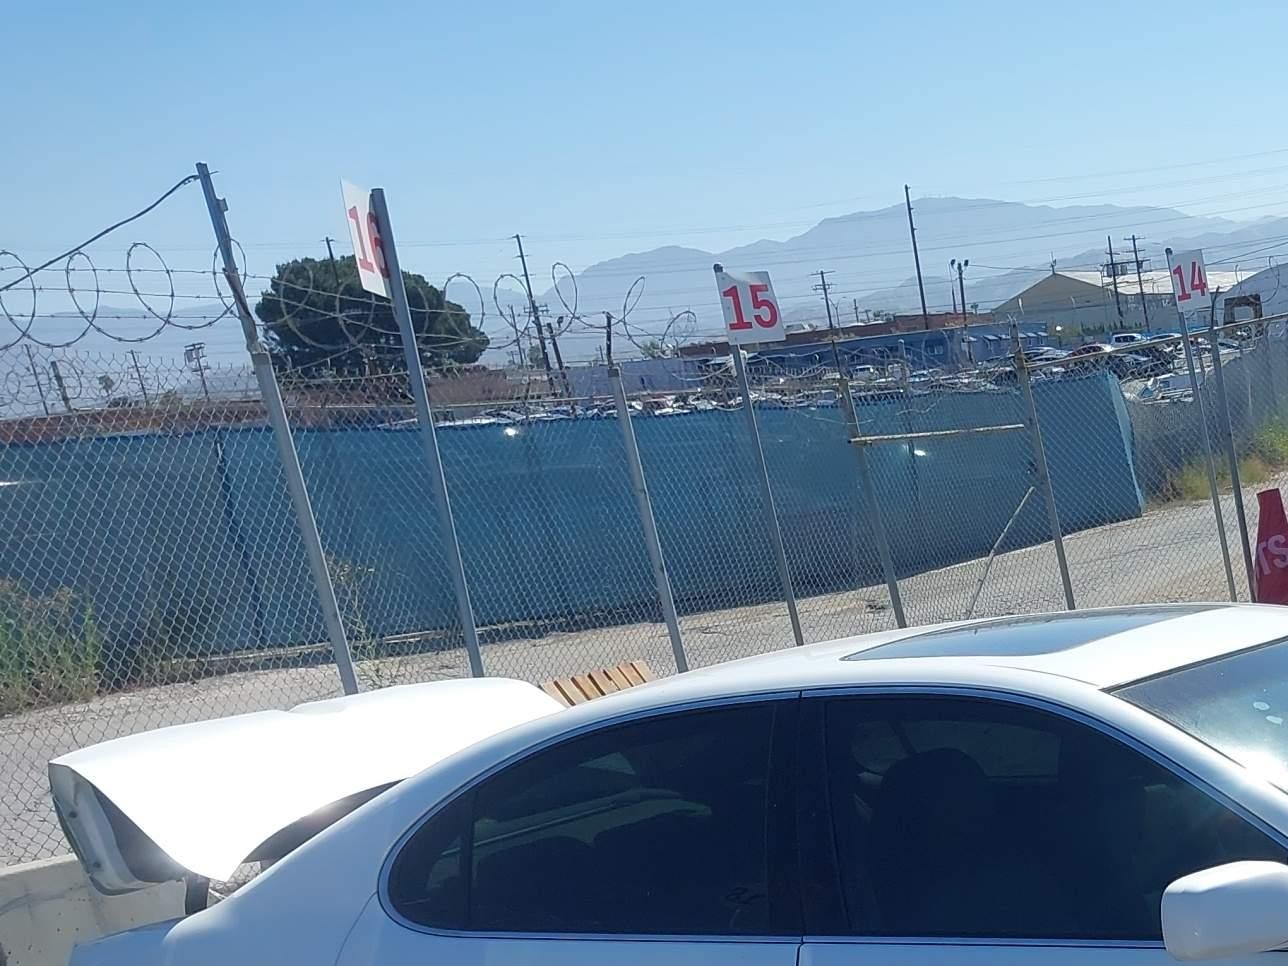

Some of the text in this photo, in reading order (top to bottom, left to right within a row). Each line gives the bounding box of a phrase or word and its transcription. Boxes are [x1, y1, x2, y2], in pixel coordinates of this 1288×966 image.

[348, 206, 391, 278] 16
[1173, 261, 1207, 301] 14
[723, 284, 778, 330] 15
